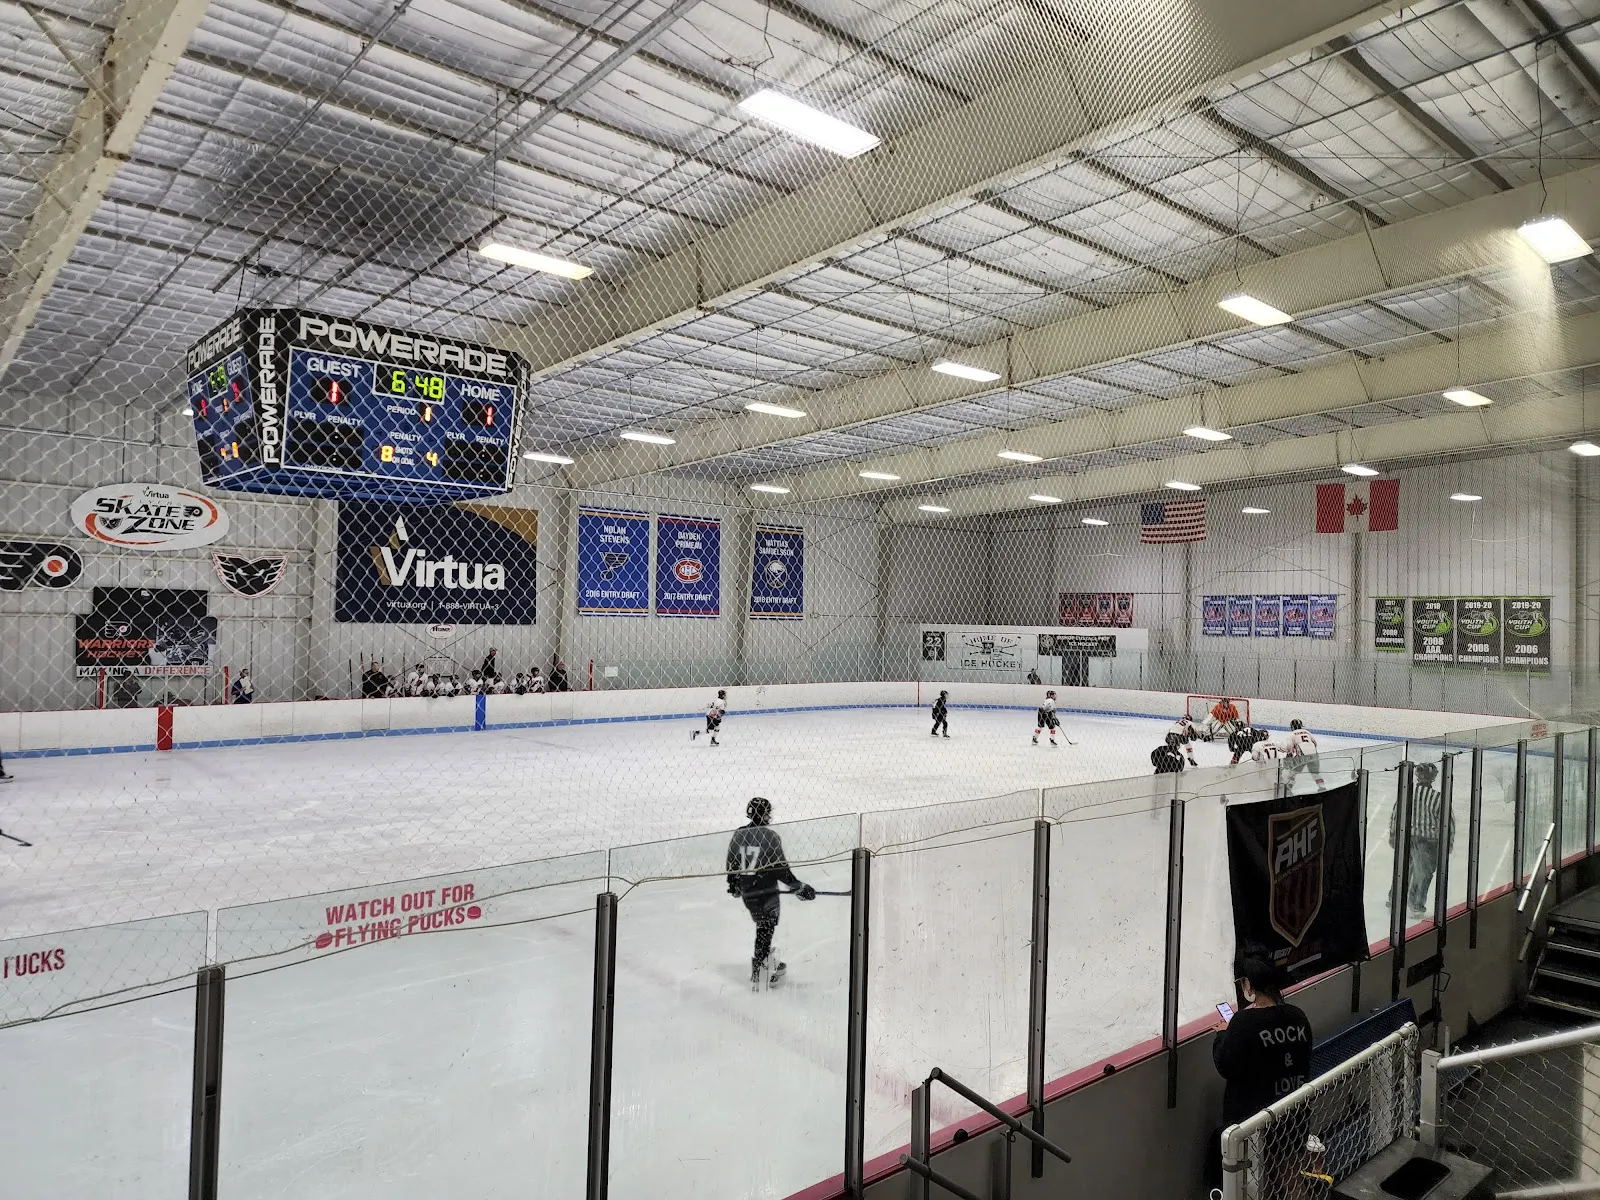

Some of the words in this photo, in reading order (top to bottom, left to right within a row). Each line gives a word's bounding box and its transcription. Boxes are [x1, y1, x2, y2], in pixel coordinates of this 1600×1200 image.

[188, 317, 241, 373] POWERADE
[300, 316, 507, 377] POWERADE
[307, 358, 362, 378] GUEST
[259, 317, 280, 463] POWERADE
[461, 384, 501, 402] HOME
[293, 410, 317, 420] PLYR
[328, 415, 361, 426] PENALTY
[386, 405, 416, 416] PERIOD
[390, 431, 421, 442] PENALTY
[446, 431, 466, 441] PLYR
[476, 435, 505, 445] PENALTY
[381, 445, 393, 462] 8
[426, 451, 438, 467] 4
[143, 488, 170, 499] Virtua
[94, 498, 182, 518] SKATE
[119, 515, 195, 535] ZONE
[604, 525, 627, 535] NOLAN
[599, 534, 630, 545] STEVENS
[370, 546, 505, 590] Virtua
[601, 589, 620, 598] ENTRY
[621, 590, 640, 599] DRAFT
[386, 599, 427, 611] virtua.org
[1464, 601, 1493, 609] 2019-20
[1511, 601, 1542, 609] 2019-20
[78, 639, 156, 649] WARRIORS
[981, 659, 1021, 669] HOCKEY
[1414, 653, 1453, 662] CHAMPIONS
[1458, 655, 1500, 664] CHAMPIONS
[1505, 656, 1549, 665] CHAMPIONS
[144, 666, 210, 675] DIFFERENCE
[1275, 818, 1318, 875] AHF
[739, 846, 761, 875] 17
[325, 896, 396, 926] WATCH
[401, 890, 435, 913] OUT
[441, 883, 475, 906] FOR
[335, 918, 401, 948] FLYING
[408, 906, 465, 935] PUCKS
[1259, 1025, 1308, 1048] ROCK
[1284, 1052, 1294, 1068] &
[1274, 1075, 1305, 1096] LOVE
